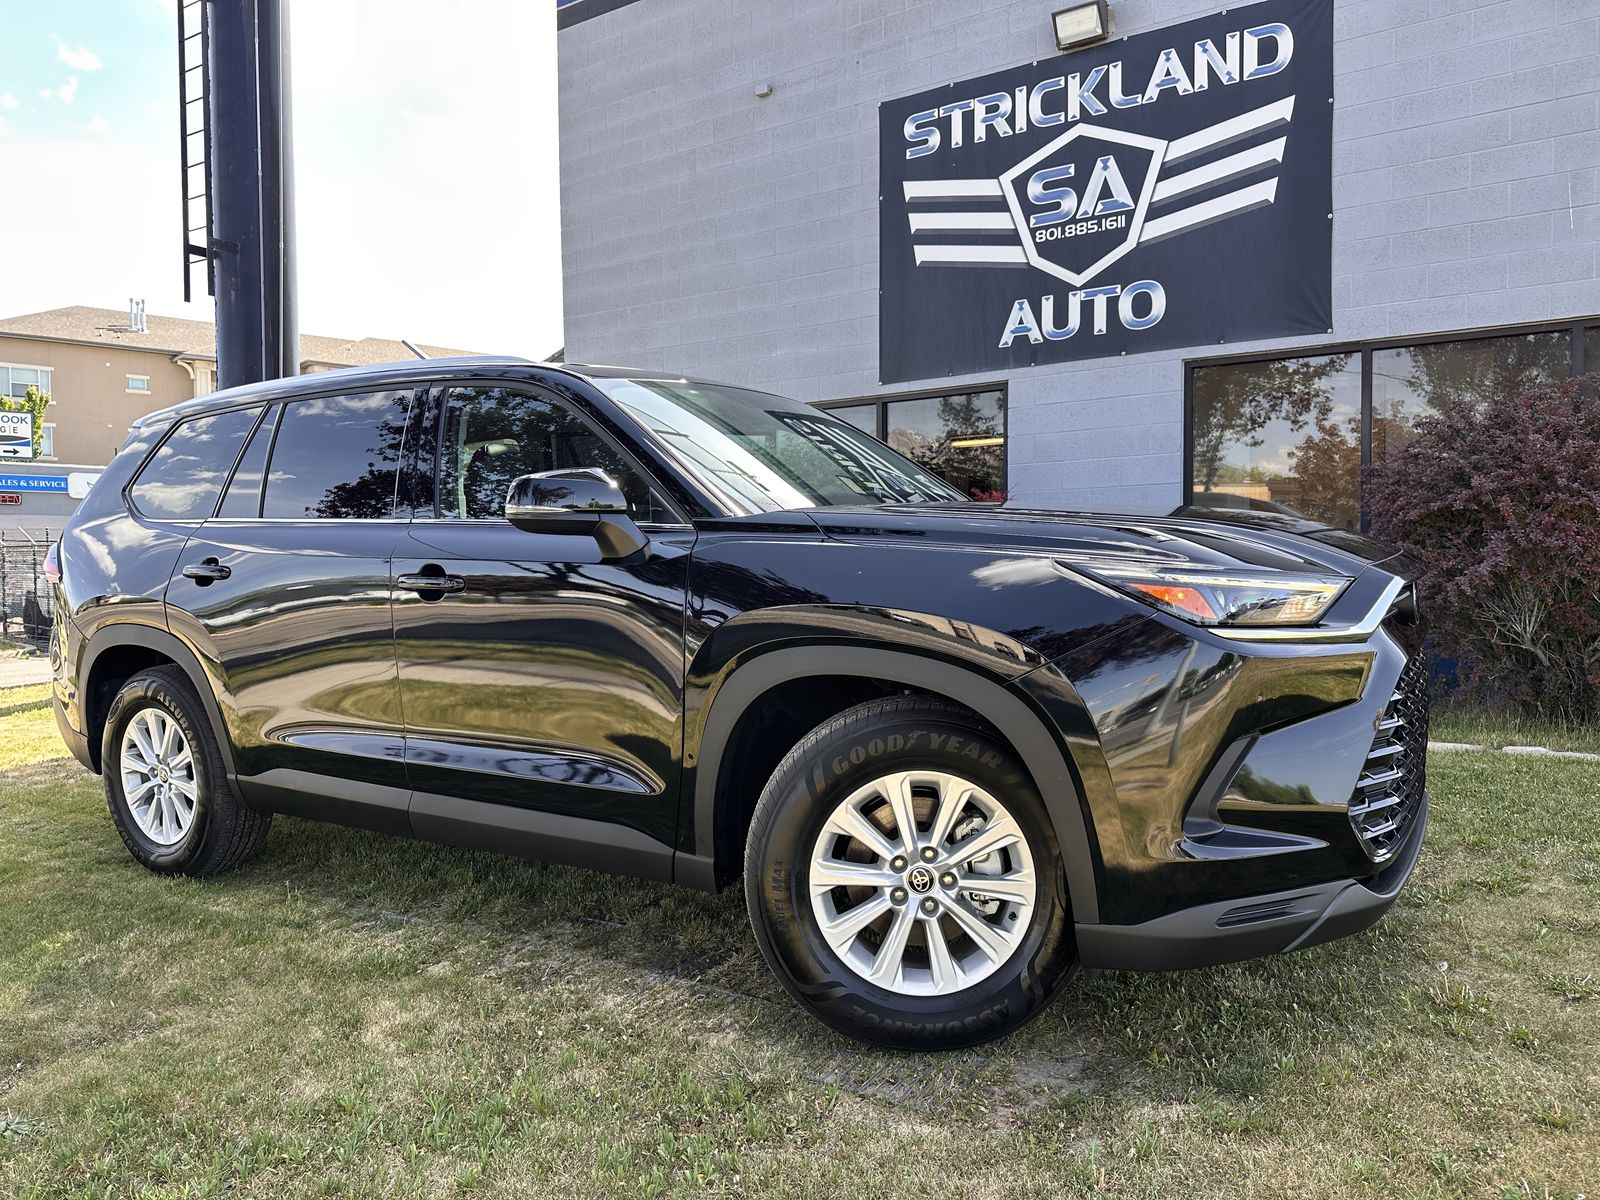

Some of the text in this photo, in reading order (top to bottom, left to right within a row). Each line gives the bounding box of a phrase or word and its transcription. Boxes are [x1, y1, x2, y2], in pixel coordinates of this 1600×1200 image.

[903, 22, 1295, 160] STRICKLAND
[1026, 155, 1136, 228] SA
[1035, 214, 1126, 242] 801.885.1611
[999, 279, 1167, 348] AUTO
[29, 480, 67, 488] SERVICE
